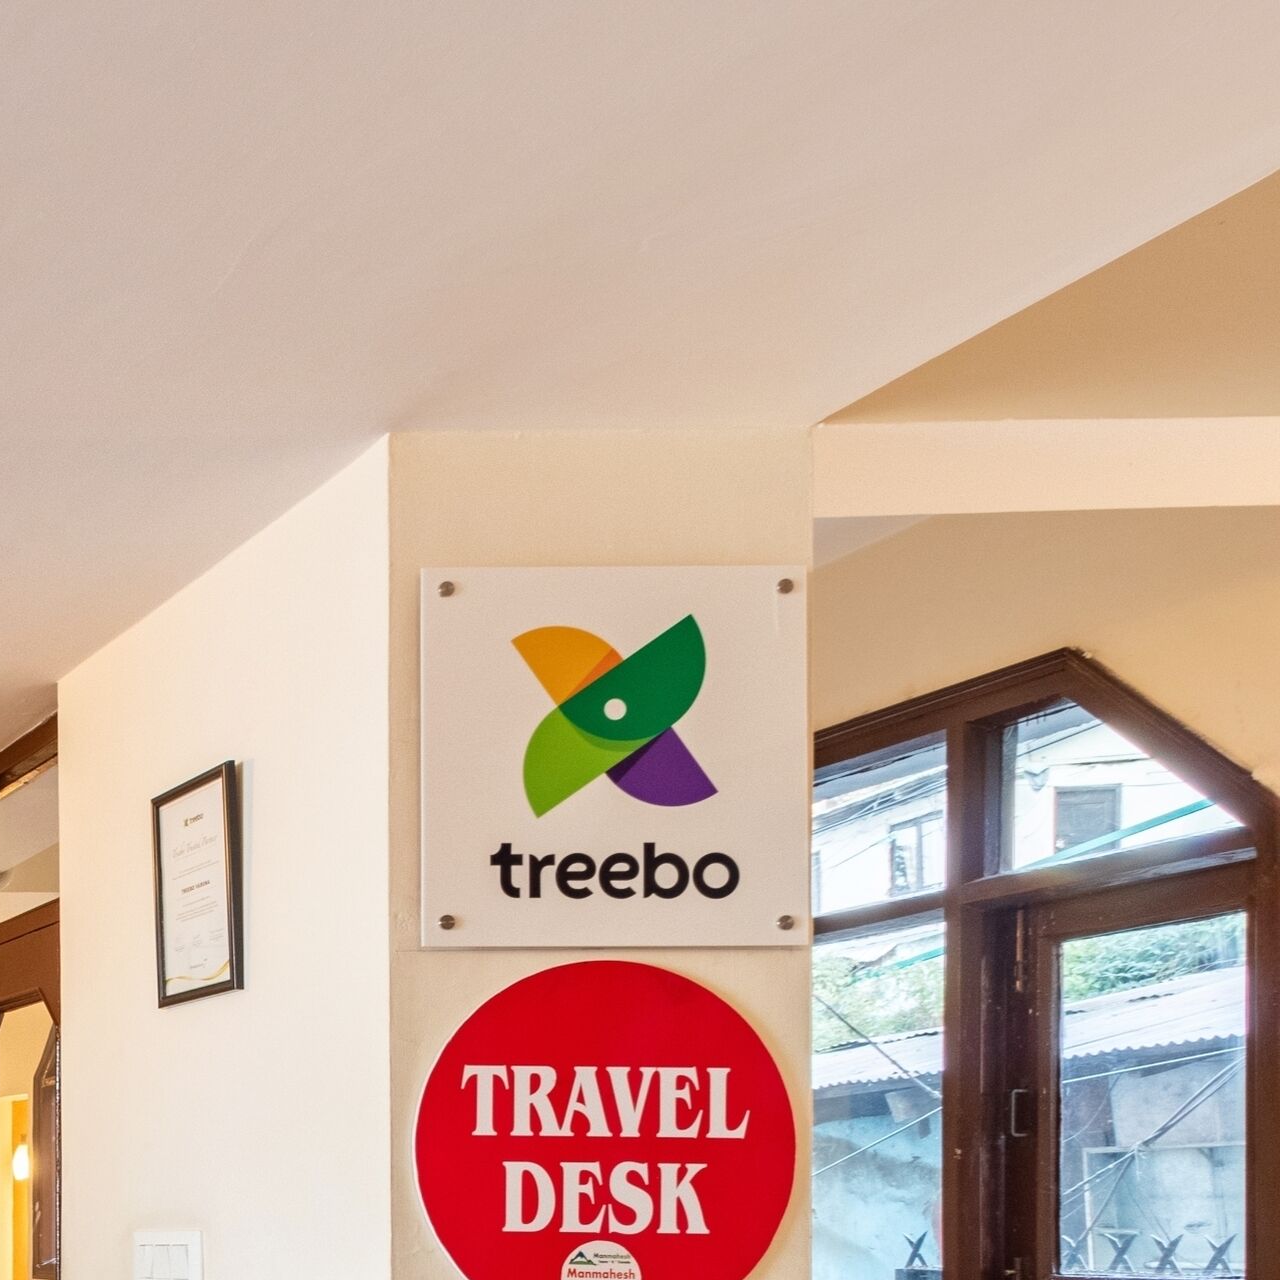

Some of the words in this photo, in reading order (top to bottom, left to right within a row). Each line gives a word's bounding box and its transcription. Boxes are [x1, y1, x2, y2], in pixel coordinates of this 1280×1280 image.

[490, 842, 740, 900] treebo
[461, 1065, 751, 1140] TRAVEL
[502, 1161, 710, 1235] DESK
[567, 1268, 636, 1280] Manmahesh
